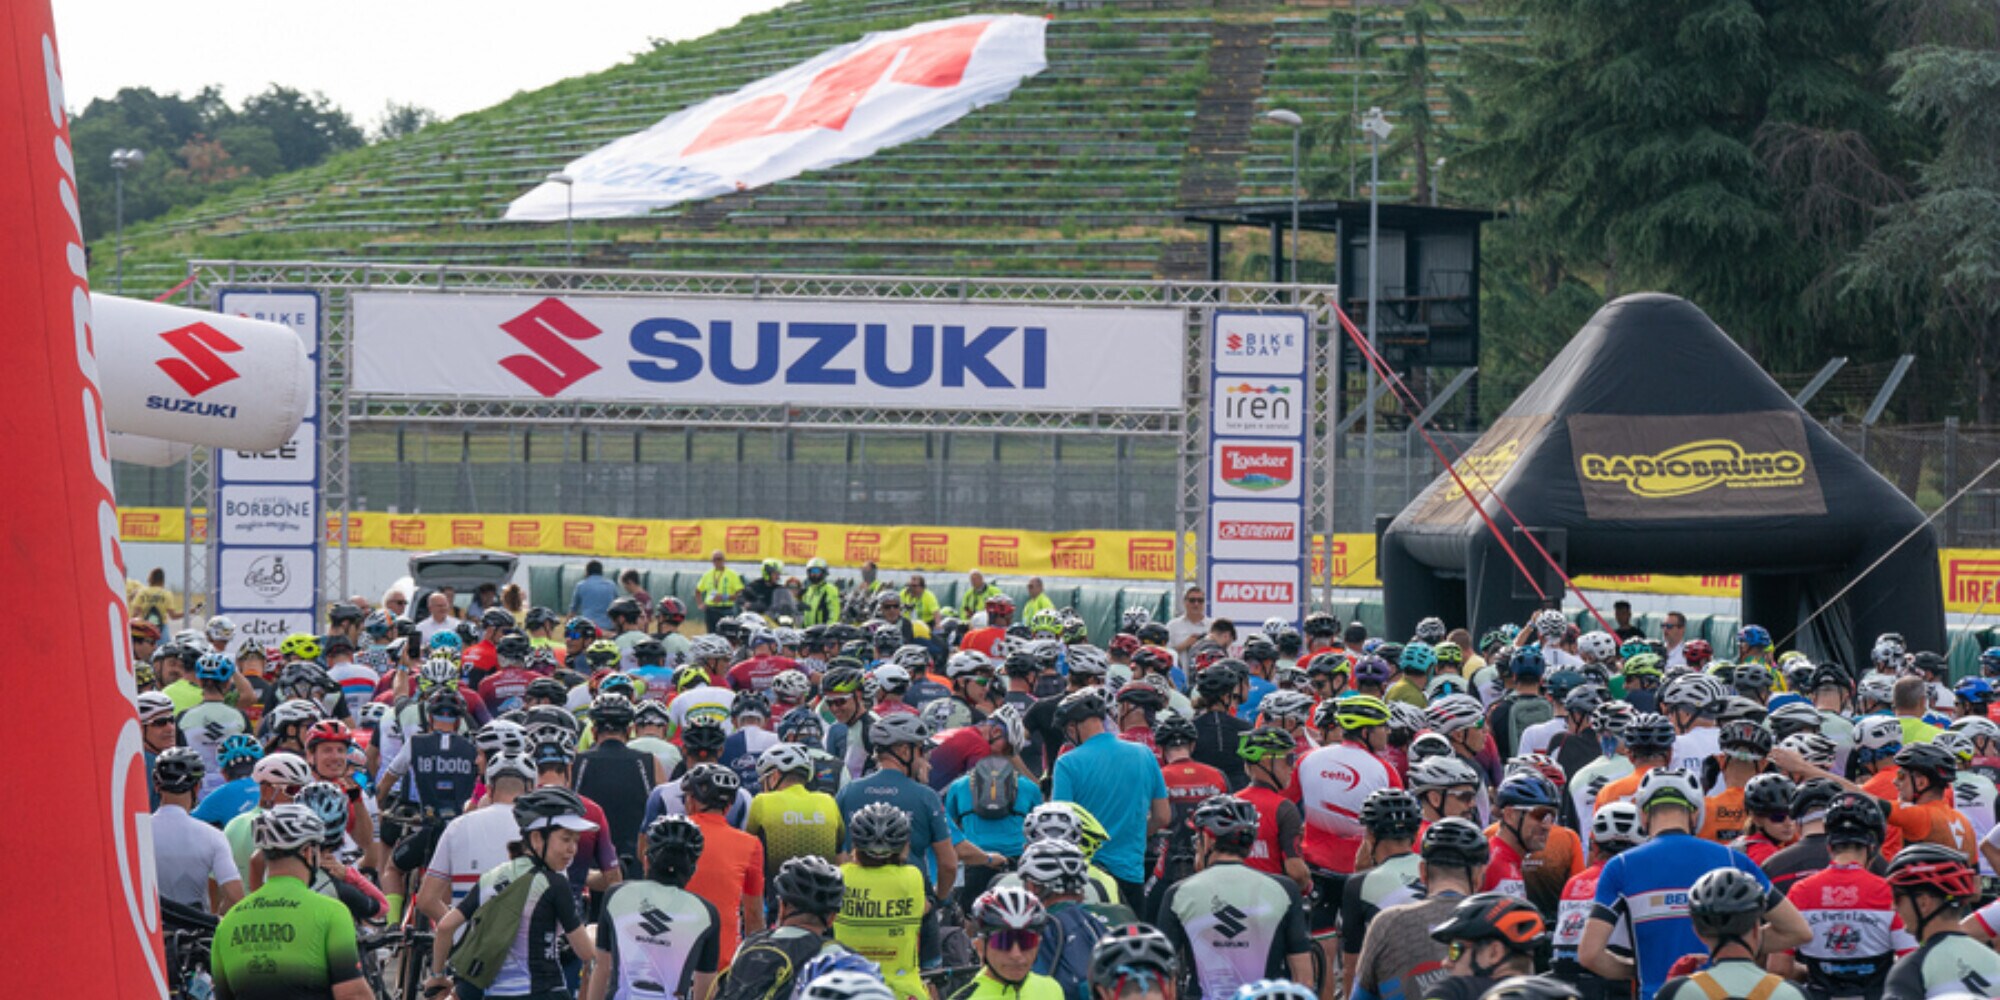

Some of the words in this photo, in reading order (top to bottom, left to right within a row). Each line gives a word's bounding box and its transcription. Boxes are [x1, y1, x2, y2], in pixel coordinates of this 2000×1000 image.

[1246, 333, 1294, 347] BIKE
[1246, 346, 1281, 356] DAY
[628, 317, 1047, 390] SUZUKI
[146, 395, 237, 419] SUZUKI
[1230, 452, 1287, 470] Loacker
[1583, 451, 1804, 481] RADIOBRUNO
[226, 500, 310, 517] BORBONE
[910, 533, 948, 564] PIRELLI
[979, 535, 1019, 567] PIRELLI
[1051, 537, 1095, 570] PIRELLI
[1128, 538, 1174, 572] PIRELLI
[1220, 583, 1290, 601] MOTUL
[1949, 559, 2000, 603] PIRE
[242, 618, 291, 635] click
[231, 922, 296, 947] AMARO
